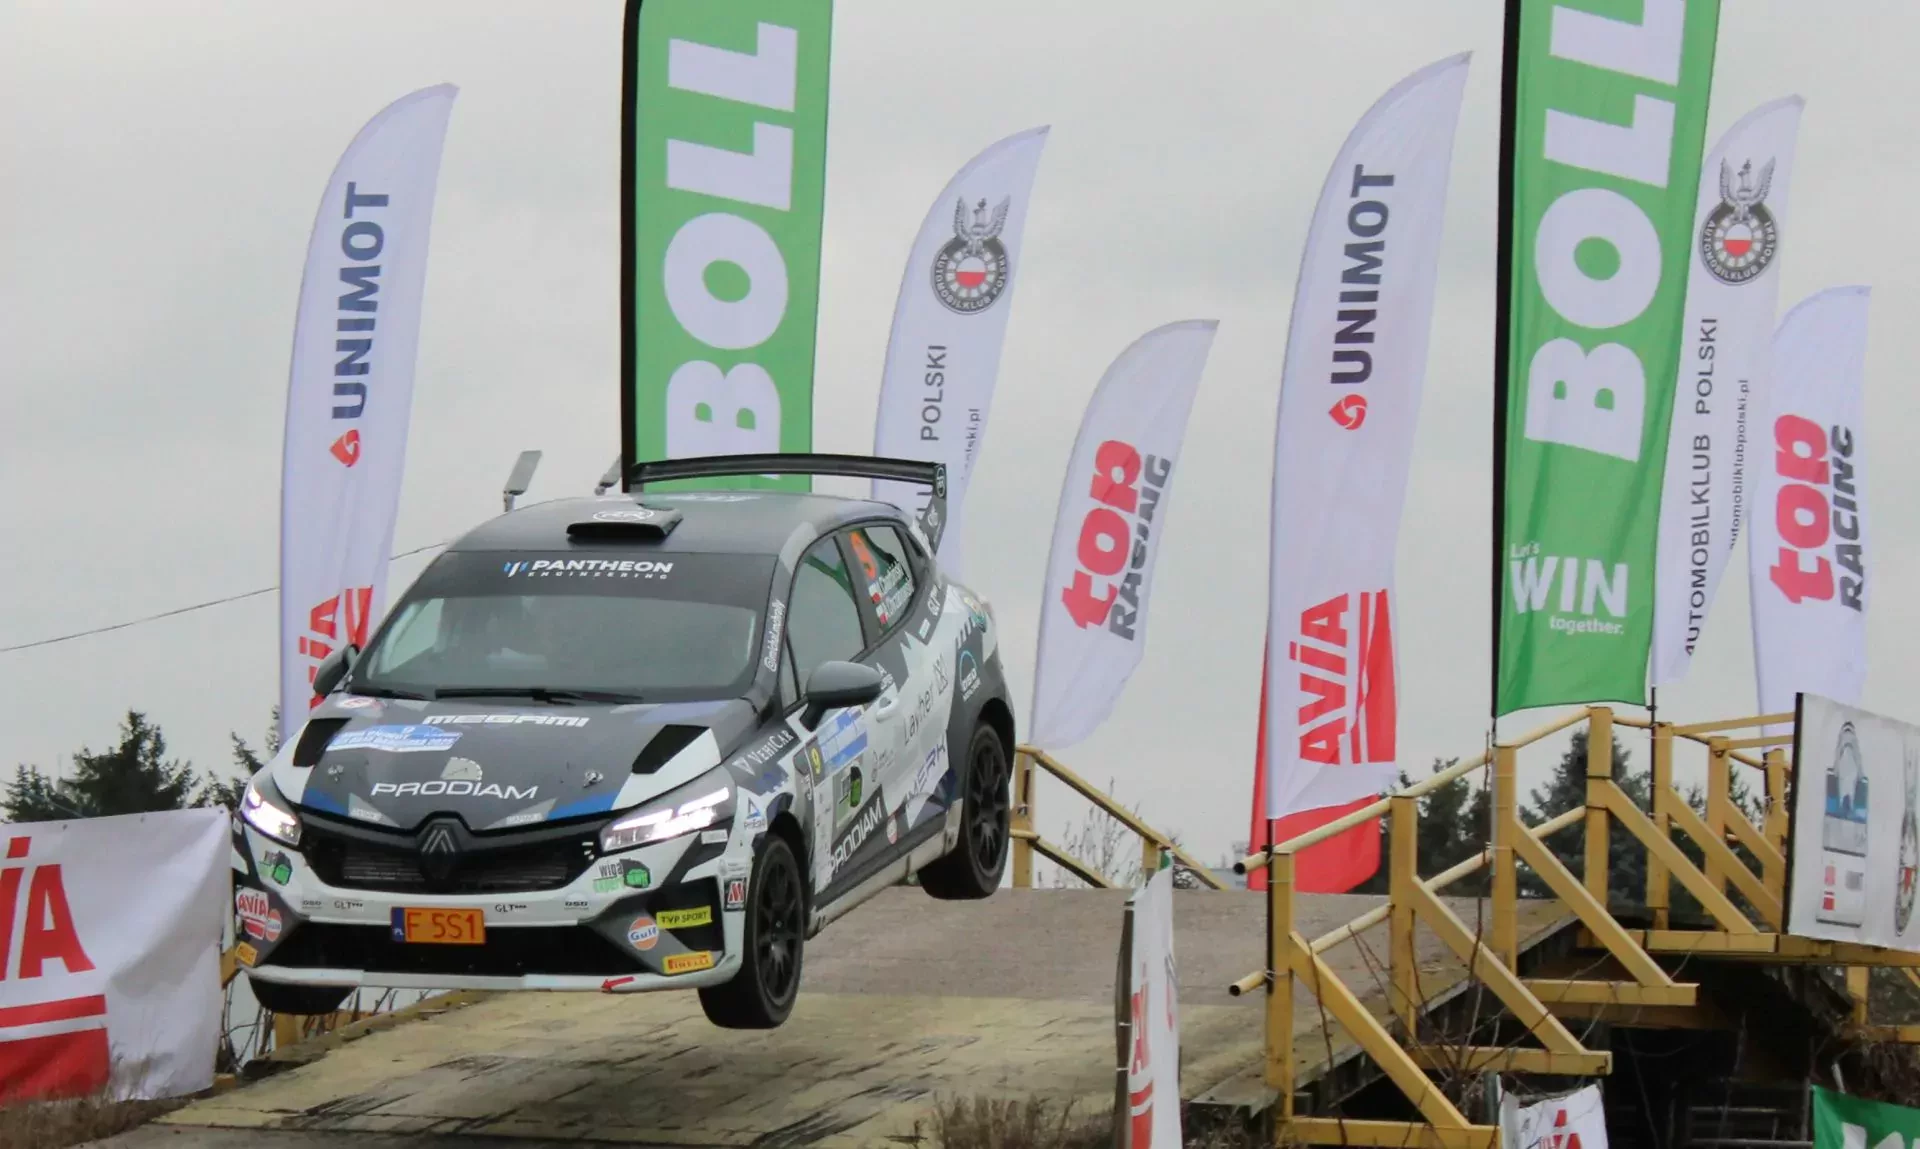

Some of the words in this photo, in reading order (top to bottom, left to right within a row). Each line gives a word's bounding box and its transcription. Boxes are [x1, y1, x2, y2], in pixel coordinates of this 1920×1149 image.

[663, 22, 797, 479] BOLL
[1524, 0, 1687, 463] BOLL
[331, 181, 390, 420] UNIMOT
[1330, 163, 1395, 384] UNIMOT
[920, 345, 947, 441] POLSKI
[1695, 318, 1718, 415] POLSKI
[1108, 454, 1172, 642] RACING
[1830, 425, 1864, 613] RACING
[528, 571, 668, 580] ENGINEERING
[531, 559, 674, 574] PANTHEON
[1509, 556, 1629, 618] WIN
[422, 714, 591, 728] MEGAMI
[371, 780, 539, 800] PRODIAM
[406, 912, 422, 935] F
[630, 927, 657, 941] Gulf
[660, 914, 680, 925] TVP
[681, 910, 709, 923] SPORT
